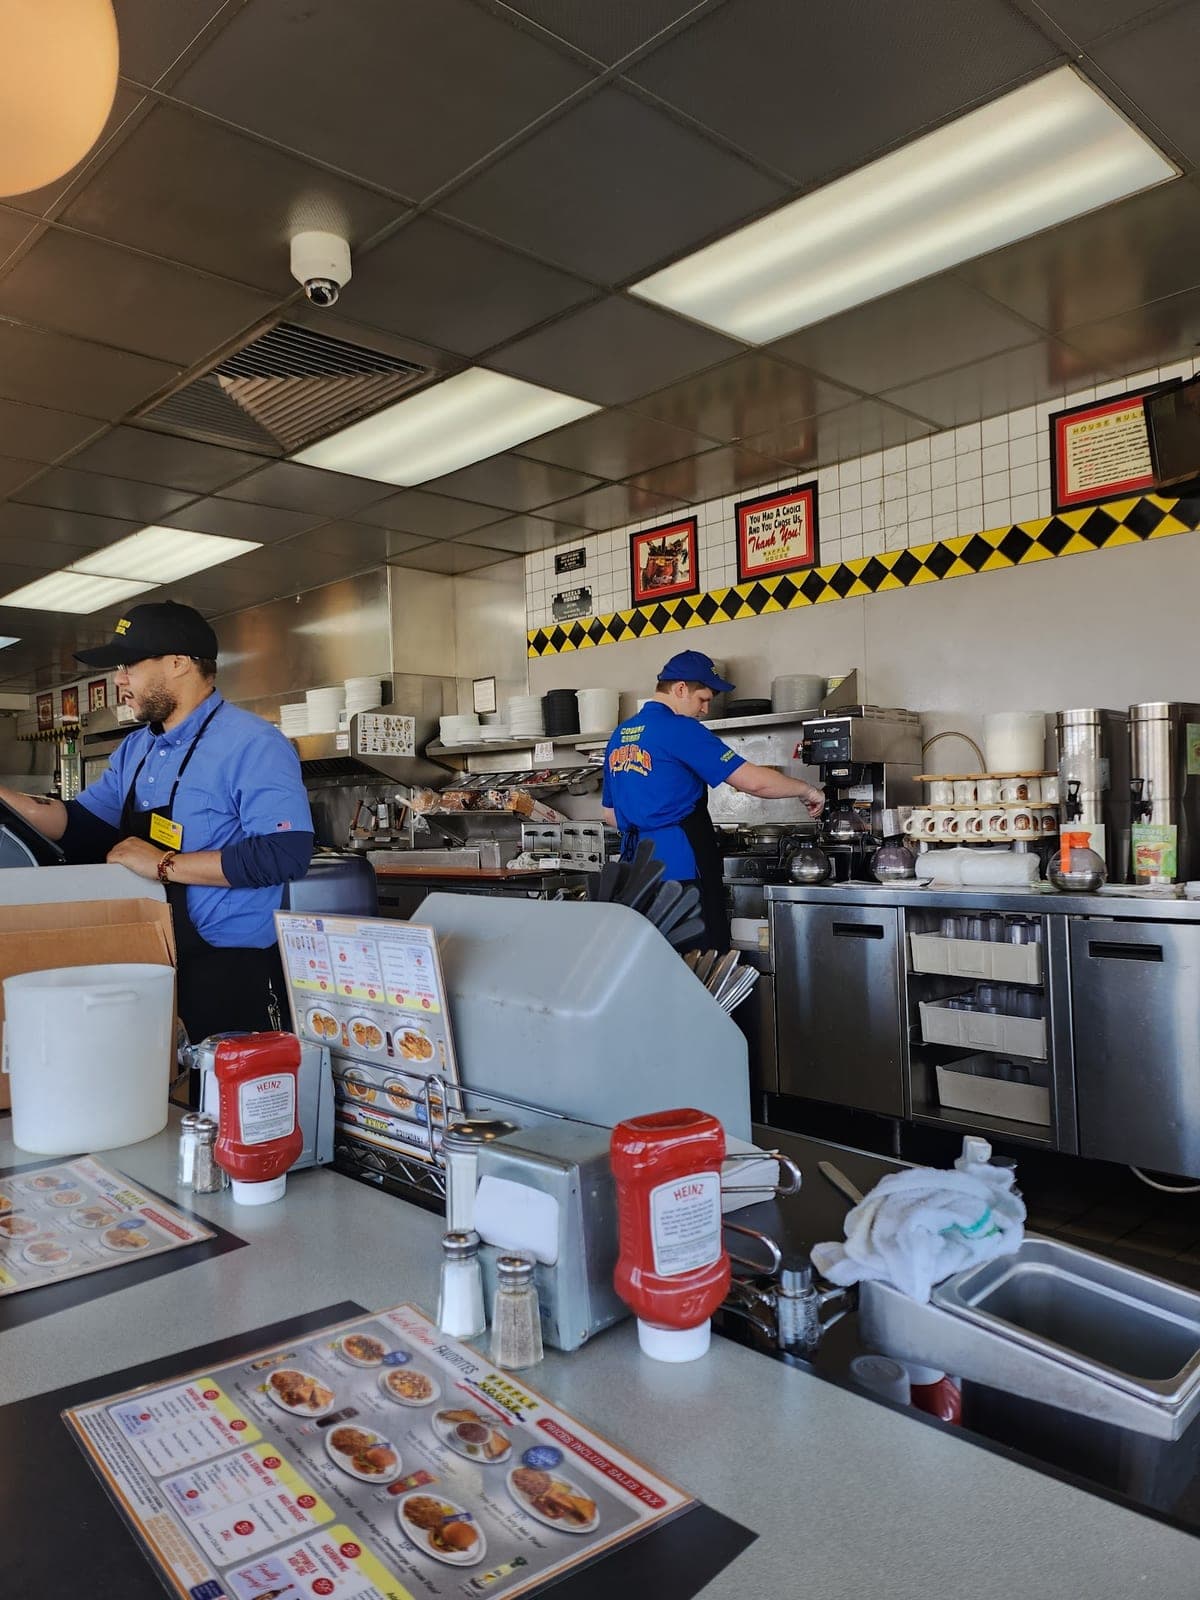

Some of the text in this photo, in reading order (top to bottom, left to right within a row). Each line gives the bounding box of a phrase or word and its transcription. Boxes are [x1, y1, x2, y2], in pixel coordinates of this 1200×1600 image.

[748, 530, 776, 553] Thank
[256, 1080, 282, 1092] HEINZ
[674, 1184, 704, 1200] HEINZ
[431, 1344, 480, 1374] FAVORITES
[541, 1422, 575, 1443] PRICES
[569, 1442, 610, 1469] INCLUDE
[606, 1468, 640, 1490] SALES
[636, 1489, 661, 1505] TAX
